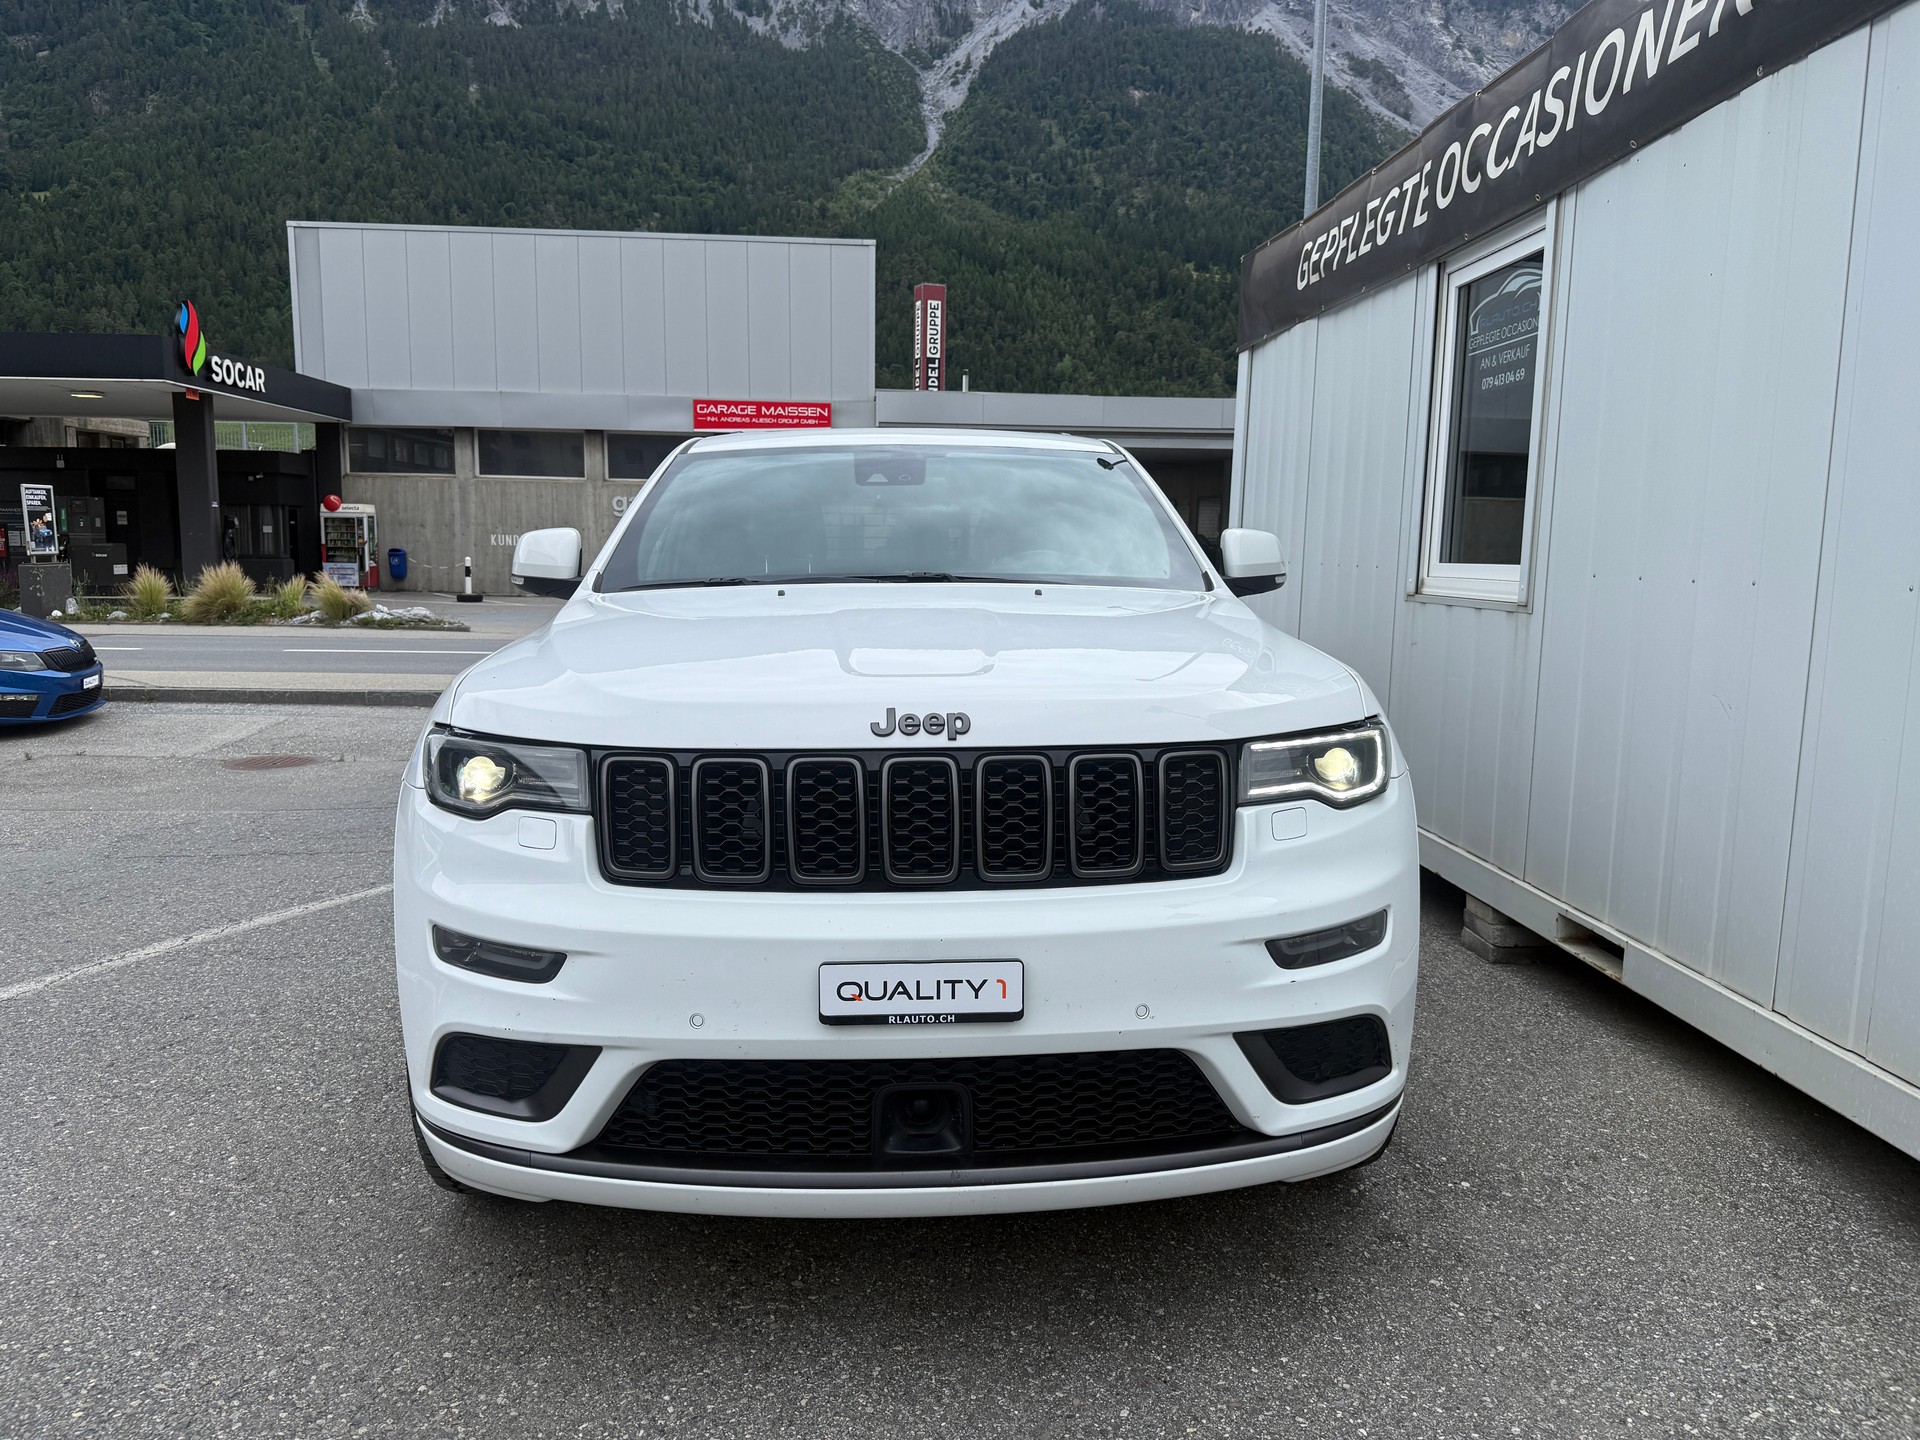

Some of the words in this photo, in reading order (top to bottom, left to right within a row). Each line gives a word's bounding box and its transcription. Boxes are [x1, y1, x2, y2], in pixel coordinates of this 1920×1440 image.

[1297, 160, 1432, 290] GEPFLEGTE
[928, 302, 940, 355] GRUPPE
[1468, 328, 1500, 350] GEPFLEGTE
[1480, 356, 1491, 370] AN
[1491, 354, 1497, 368] &
[1498, 344, 1530, 365] VERKAUF
[211, 355, 266, 393] SOCAR
[1481, 377, 1493, 390] 079
[1515, 368, 1525, 381] 69
[697, 404, 757, 415] GARAGE
[761, 406, 828, 417] MAISSEN
[870, 707, 971, 741] Jeep
[836, 979, 988, 1002] QUALITY
[996, 979, 1007, 999] 1
[888, 1014, 956, 1025] RLAUTO.CH
